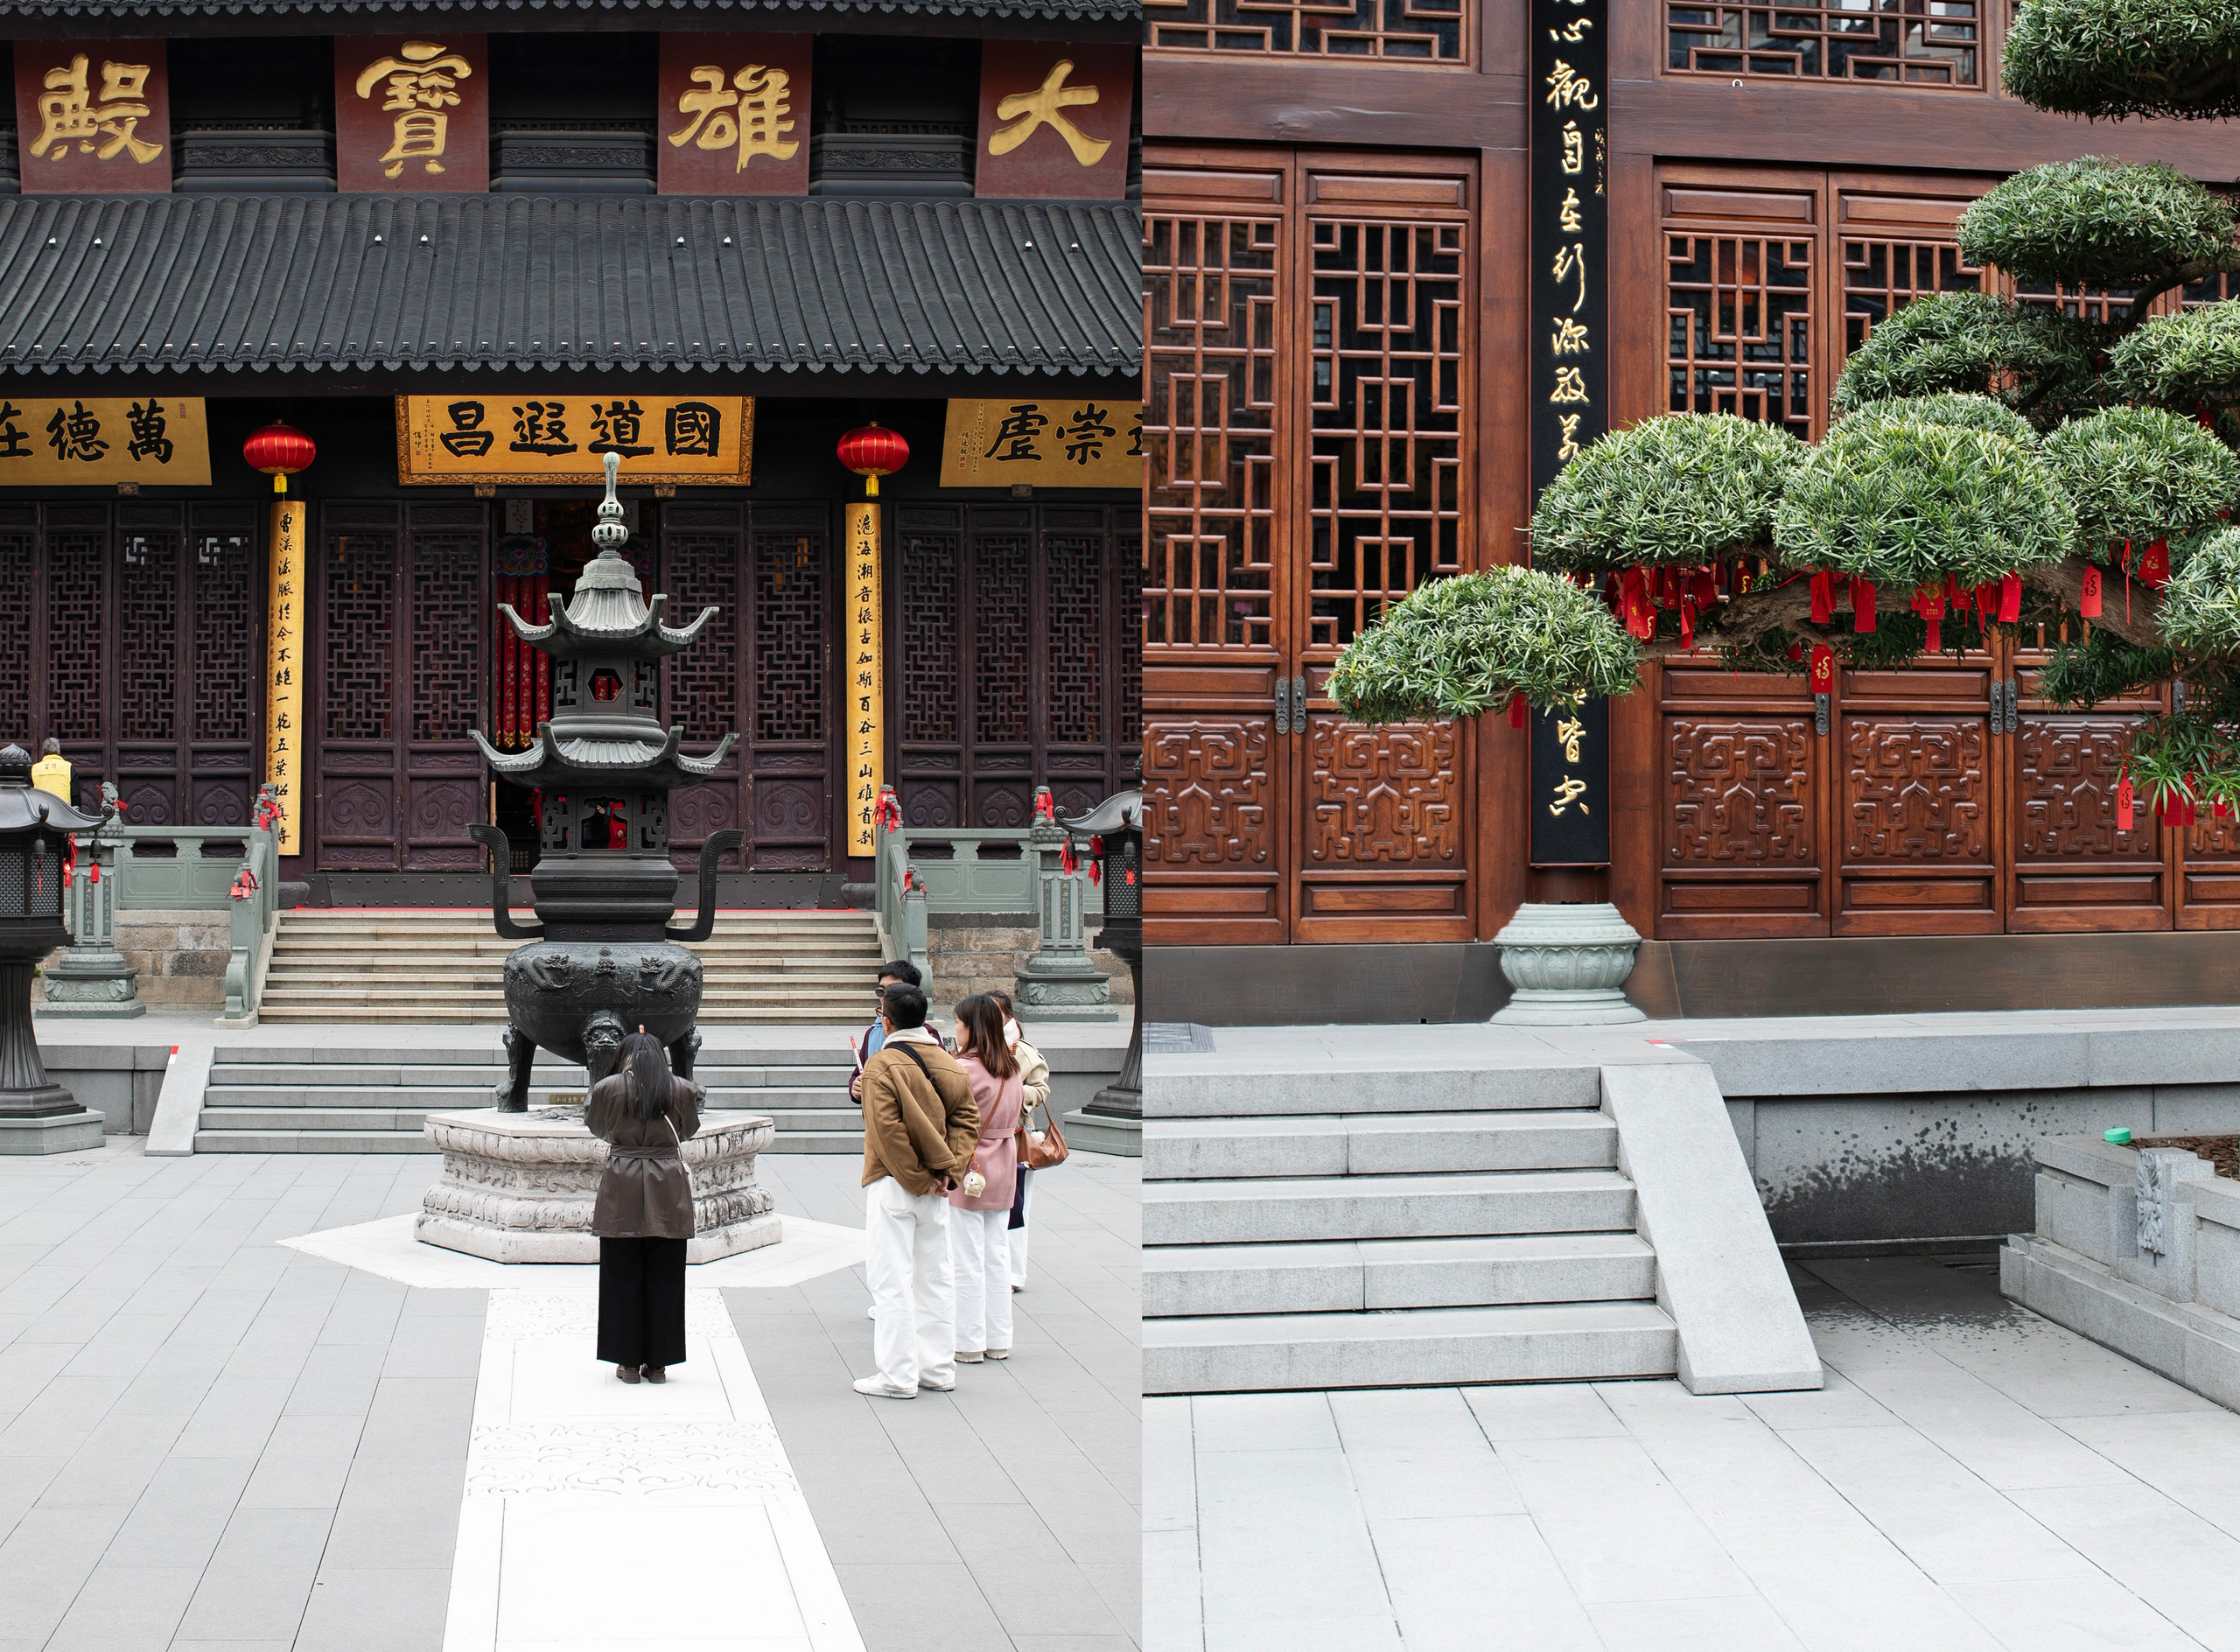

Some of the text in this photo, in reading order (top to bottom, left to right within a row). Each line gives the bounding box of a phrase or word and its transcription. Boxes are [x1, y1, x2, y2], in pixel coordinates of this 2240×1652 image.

[29, 53, 164, 162] 殿
[355, 41, 472, 179] 寶
[668, 65, 800, 174] 雄
[988, 58, 1112, 167] 大
